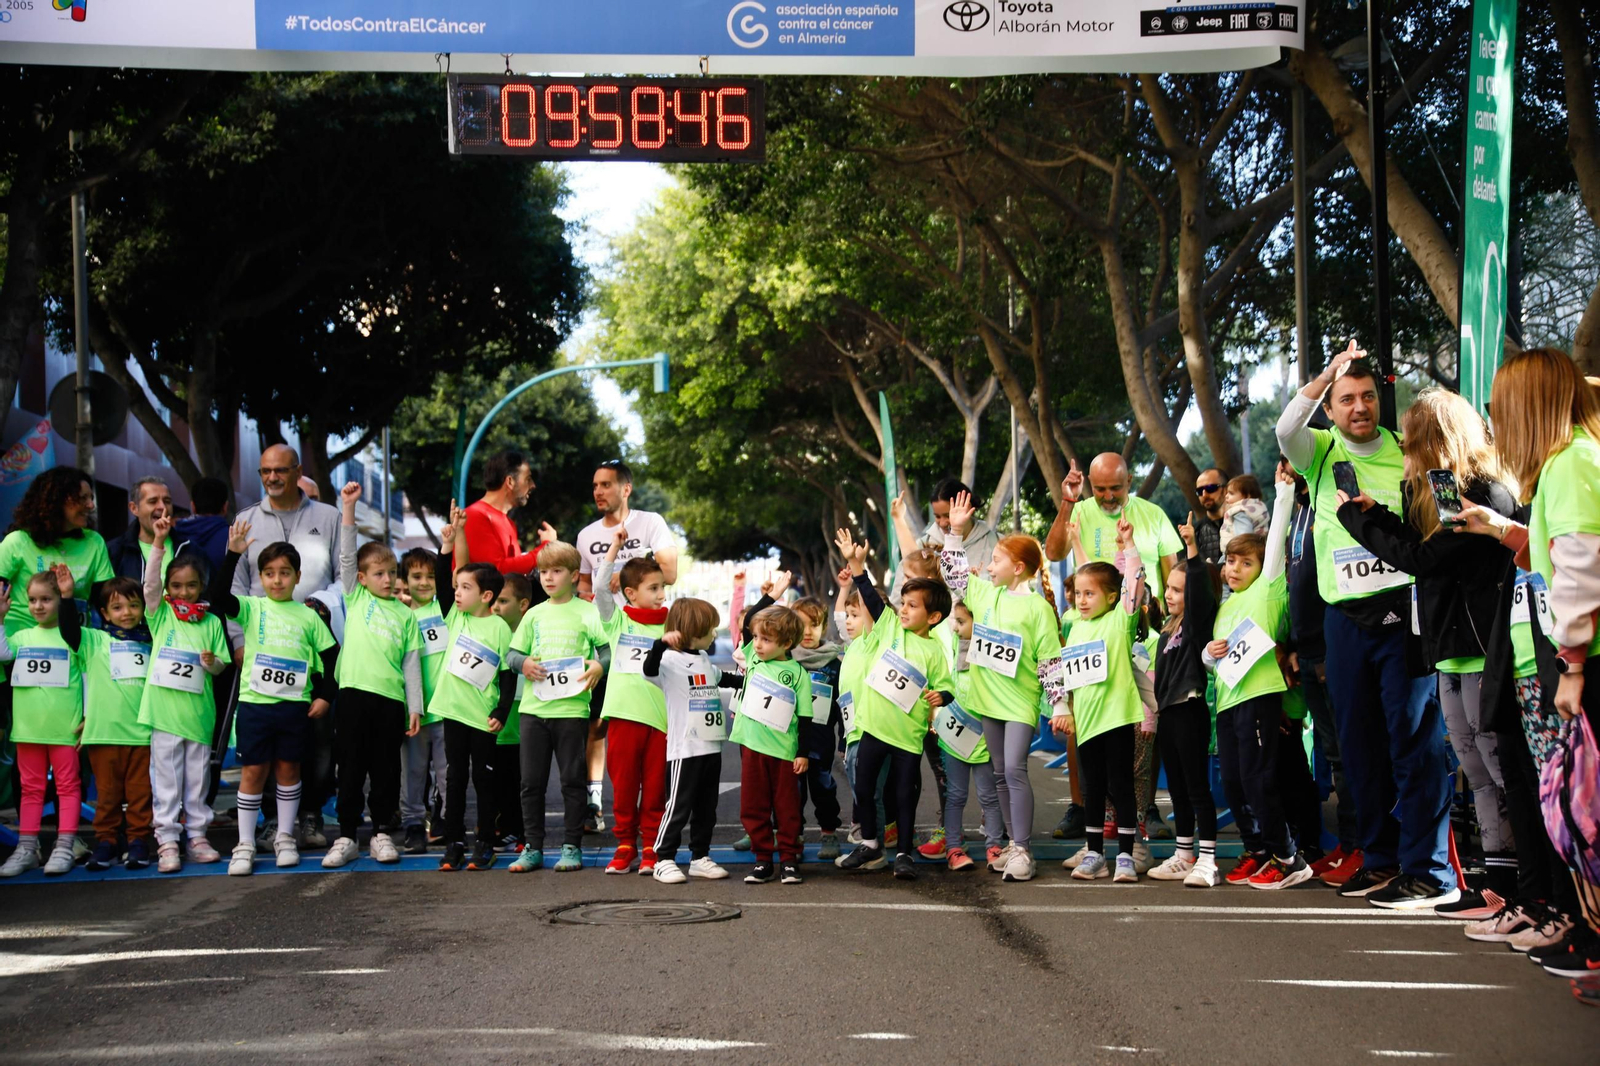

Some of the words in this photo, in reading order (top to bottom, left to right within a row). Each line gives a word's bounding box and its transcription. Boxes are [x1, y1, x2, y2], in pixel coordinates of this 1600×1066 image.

[6, 1, 34, 10] 2005
[776, 4, 842, 16] asociación
[845, 4, 899, 18] española
[998, 0, 1054, 15] Toyota
[285, 15, 486, 34] #TodosContraElCáncer
[778, 19, 817, 30] contra
[819, 18, 830, 30] el
[832, 18, 874, 30] cáncer
[998, 19, 1061, 33] Alborán
[1066, 20, 1115, 32] Motor
[1196, 16, 1223, 28] Jeep
[1230, 13, 1250, 29] FIAT
[1279, 12, 1295, 28] FIAT
[778, 34, 794, 44] en
[797, 32, 846, 44] Almería
[1473, 144, 1485, 170] por
[589, 538, 641, 555] Coke
[975, 638, 1017, 663] 1129
[1228, 640, 1252, 665] 32
[27, 659, 52, 674] 99
[133, 653, 145, 666] 3
[459, 651, 484, 670] 87
[1066, 653, 1102, 676] 1116
[168, 661, 194, 679] 22
[261, 668, 297, 687] 886
[546, 671, 569, 687] 16
[884, 668, 910, 690] 95
[763, 695, 773, 710] 1
[704, 711, 723, 727] 98
[946, 715, 965, 738] 31
